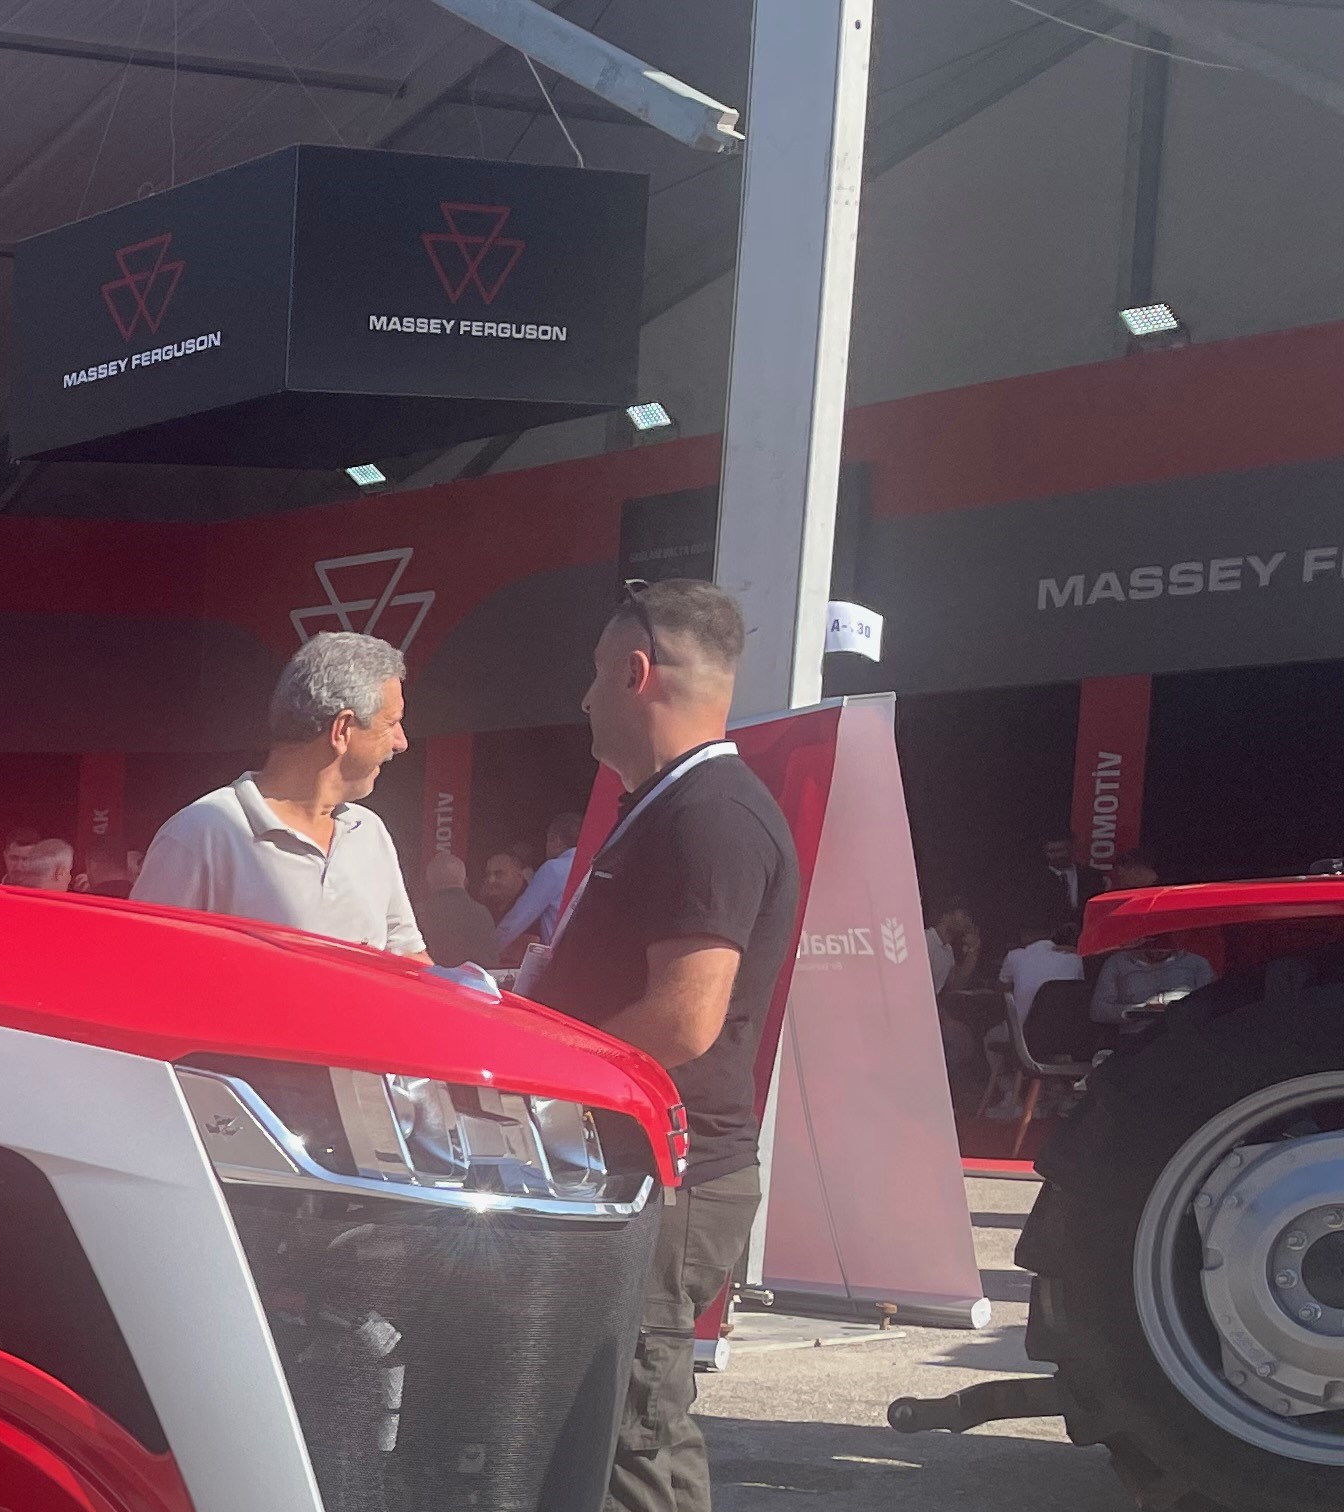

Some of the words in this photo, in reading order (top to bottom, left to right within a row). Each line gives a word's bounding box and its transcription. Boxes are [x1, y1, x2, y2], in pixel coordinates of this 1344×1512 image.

[369, 316, 455, 335] MASSEY
[459, 320, 567, 341] FERGUSON
[63, 358, 129, 389] MASSEY
[131, 331, 222, 370] FERGUSON
[1037, 552, 1287, 610] MASSEY
[1302, 547, 1344, 583] F
[831, 619, 871, 638] A-30
